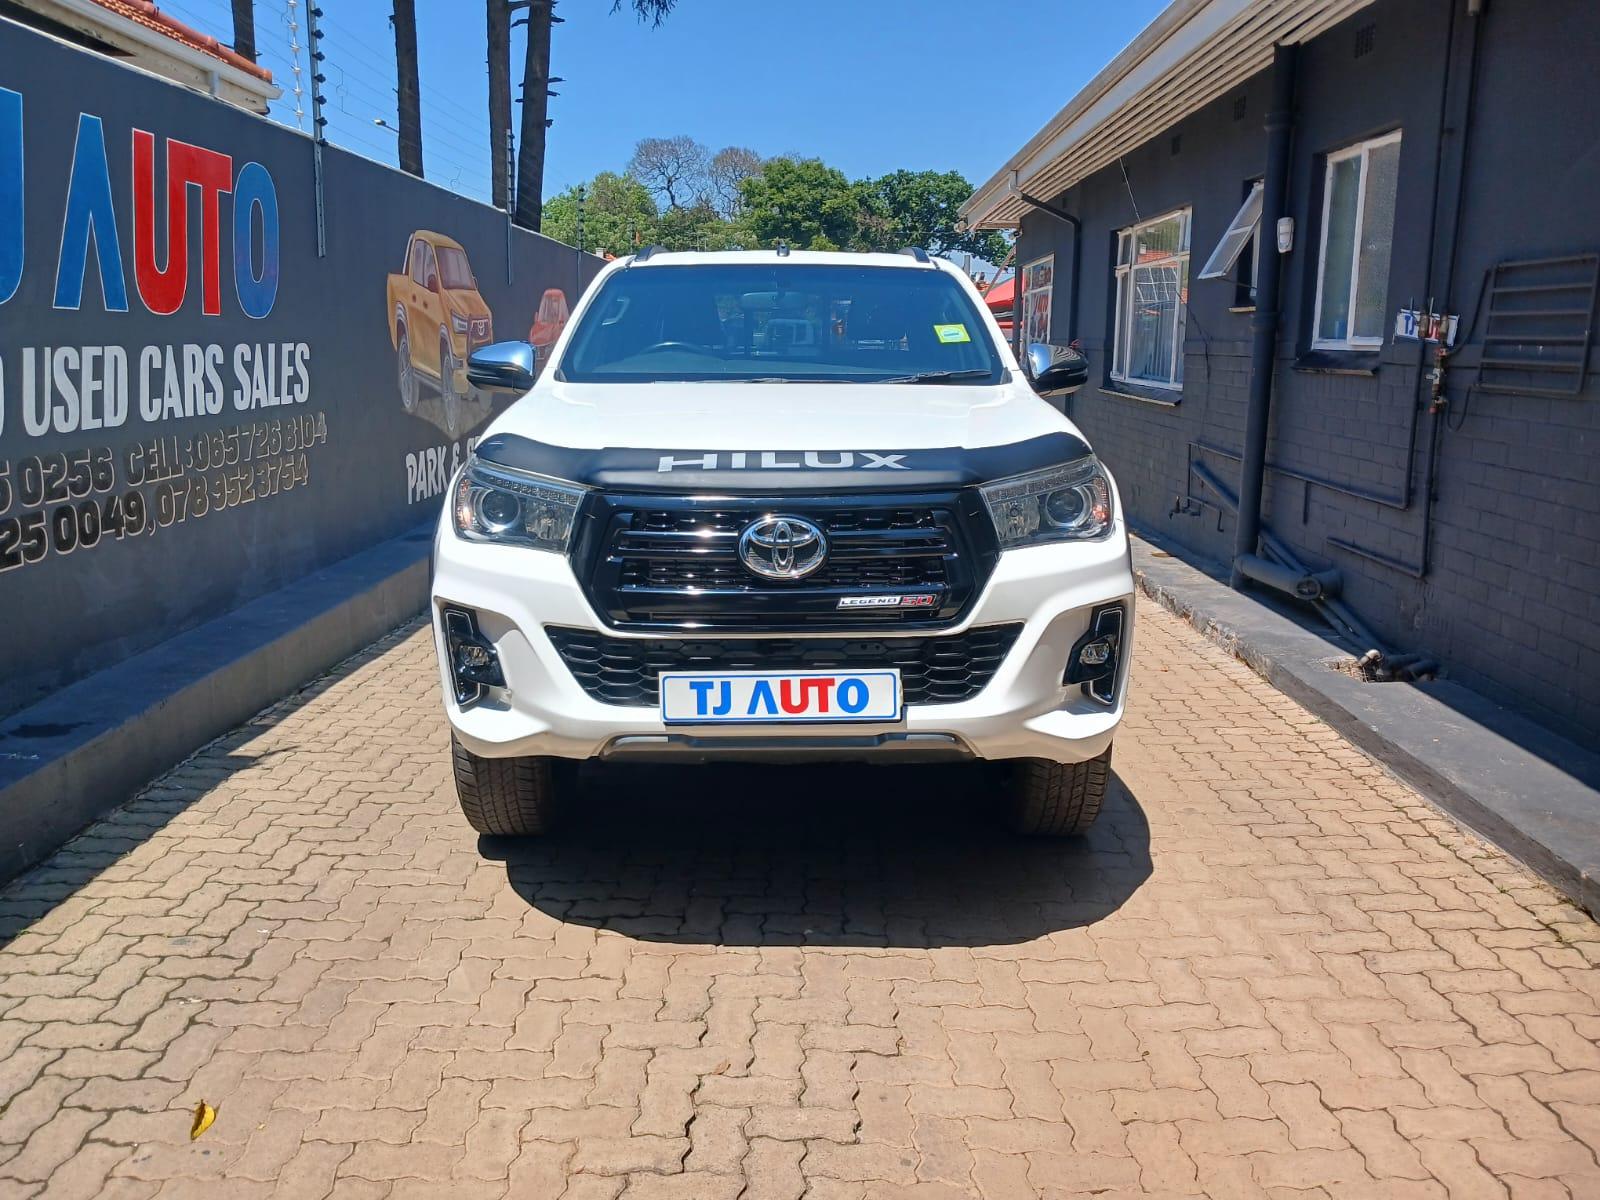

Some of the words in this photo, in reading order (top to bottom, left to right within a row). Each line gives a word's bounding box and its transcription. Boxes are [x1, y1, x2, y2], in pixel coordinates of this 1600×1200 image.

[53, 112, 279, 319] AUTO
[22, 345, 129, 437] USED
[139, 343, 224, 422] CARS
[233, 342, 311, 411] SALES
[17, 447, 115, 508] 0256
[405, 445, 449, 505] PARK
[657, 451, 912, 473] HILUX
[840, 596, 898, 606] LEGEND
[900, 595, 935, 606] 50
[689, 680, 732, 716] TJ
[747, 677, 870, 715] AUTO
